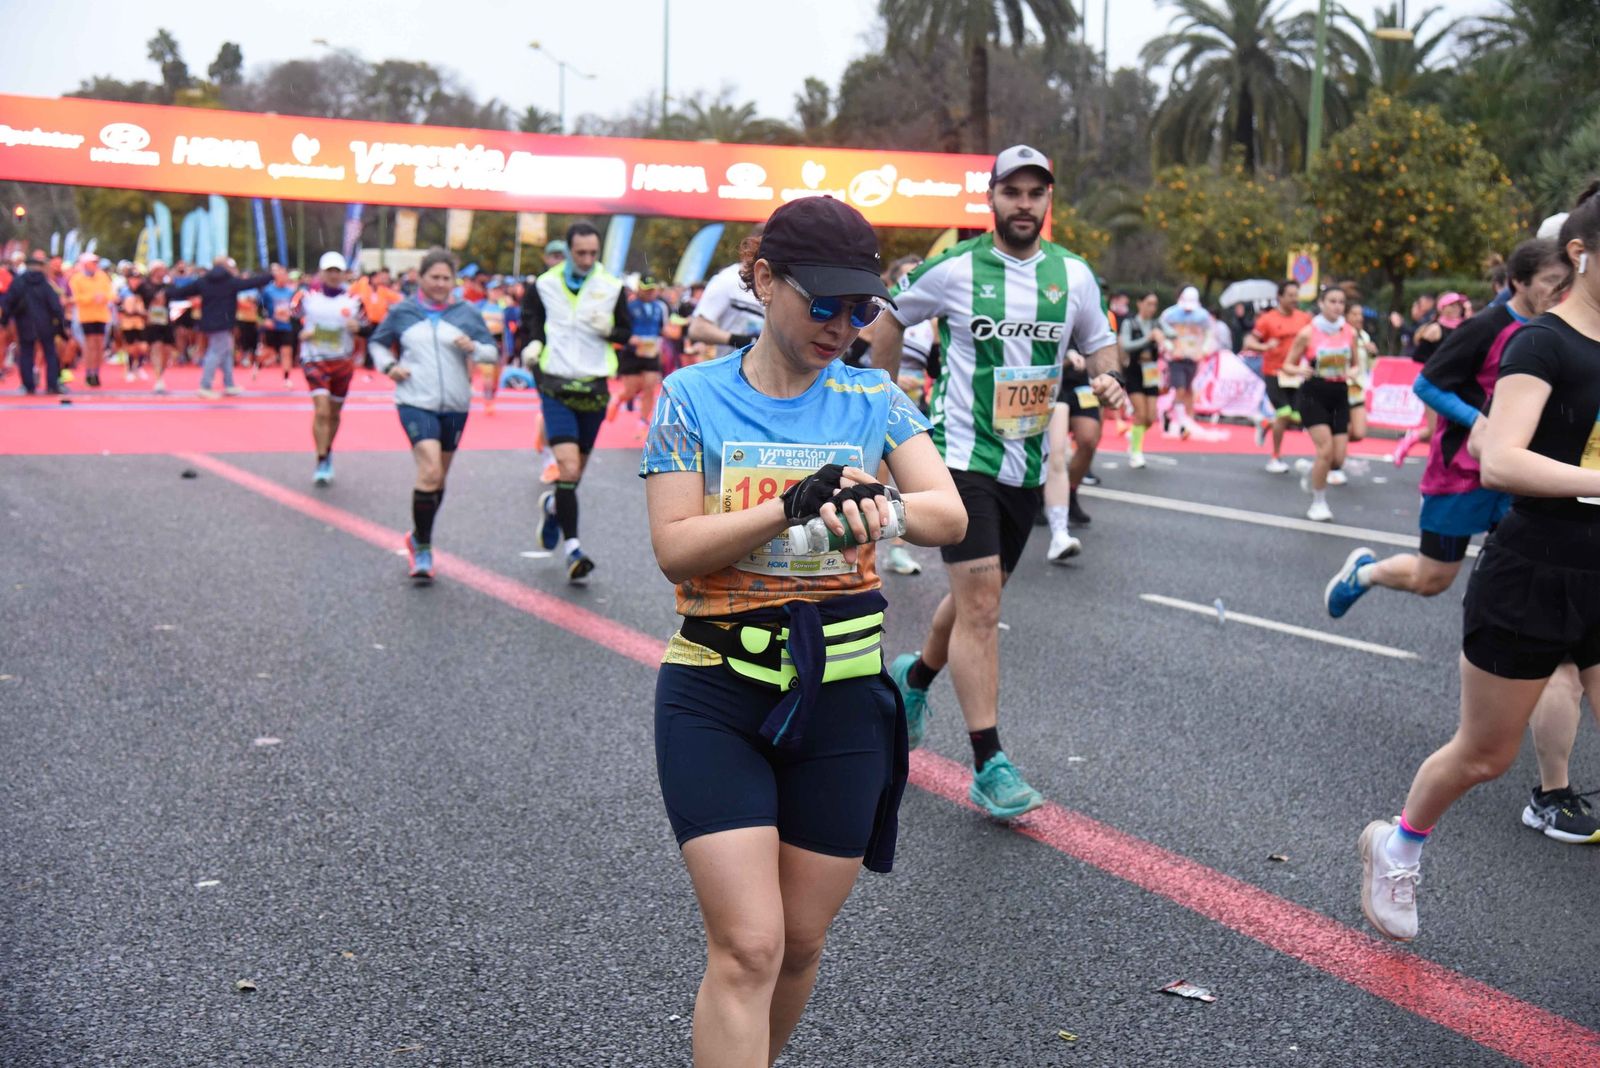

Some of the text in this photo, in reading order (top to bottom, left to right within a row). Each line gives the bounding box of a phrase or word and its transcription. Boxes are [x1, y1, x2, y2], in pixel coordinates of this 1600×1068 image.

[998, 322, 1064, 340] GREE
[1008, 384, 1048, 407] 7038
[776, 448, 826, 459] maratón
[786, 457, 825, 467] sevilla
[767, 561, 789, 569] HOKA
